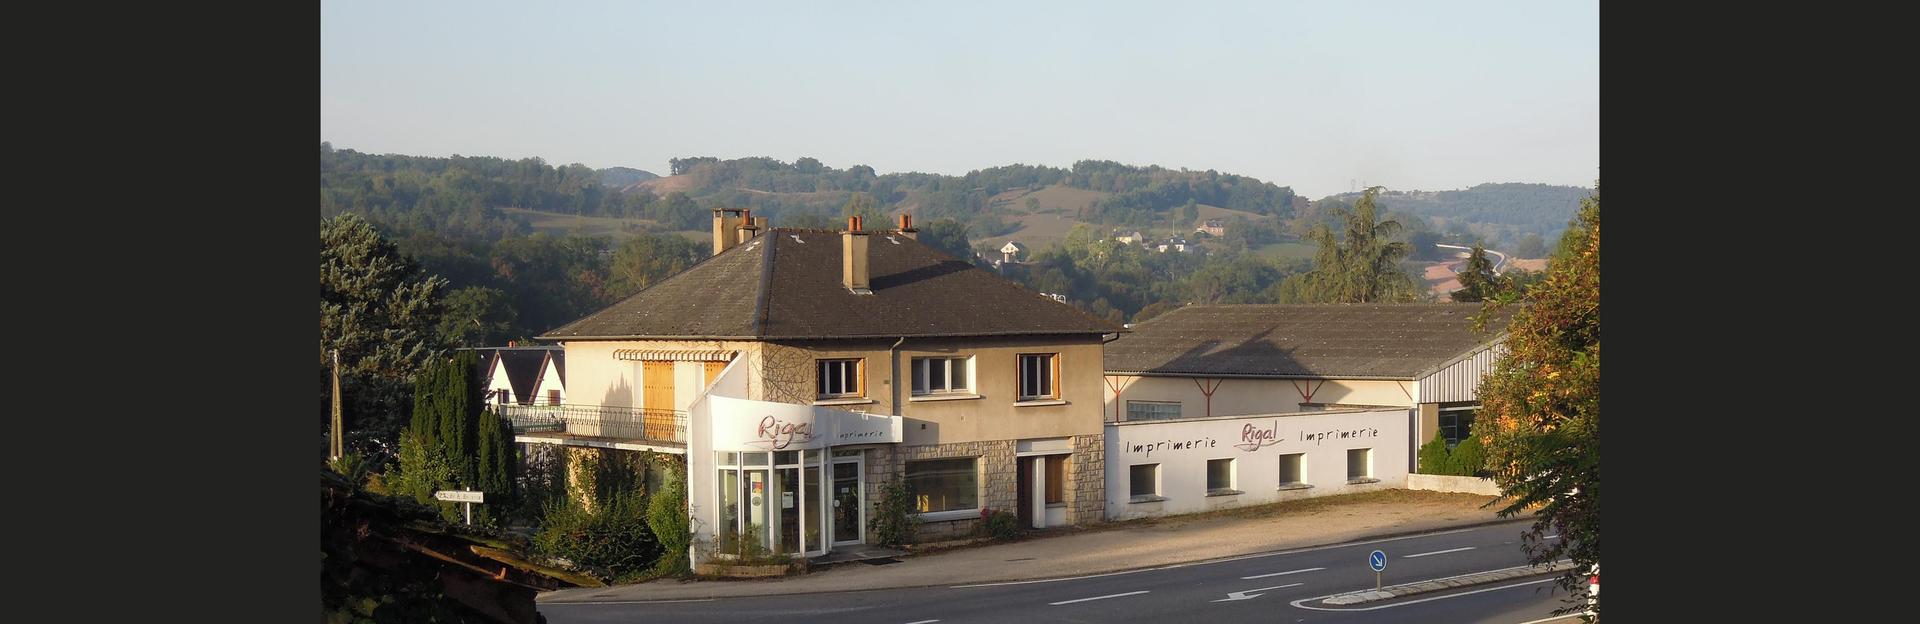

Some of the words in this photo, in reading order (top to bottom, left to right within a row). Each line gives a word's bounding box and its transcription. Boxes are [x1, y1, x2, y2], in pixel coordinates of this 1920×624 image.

[1126, 437, 1217, 458] Imprimerie
[1241, 419, 1278, 452] Rigal
[1300, 427, 1379, 446] Imprimerie
